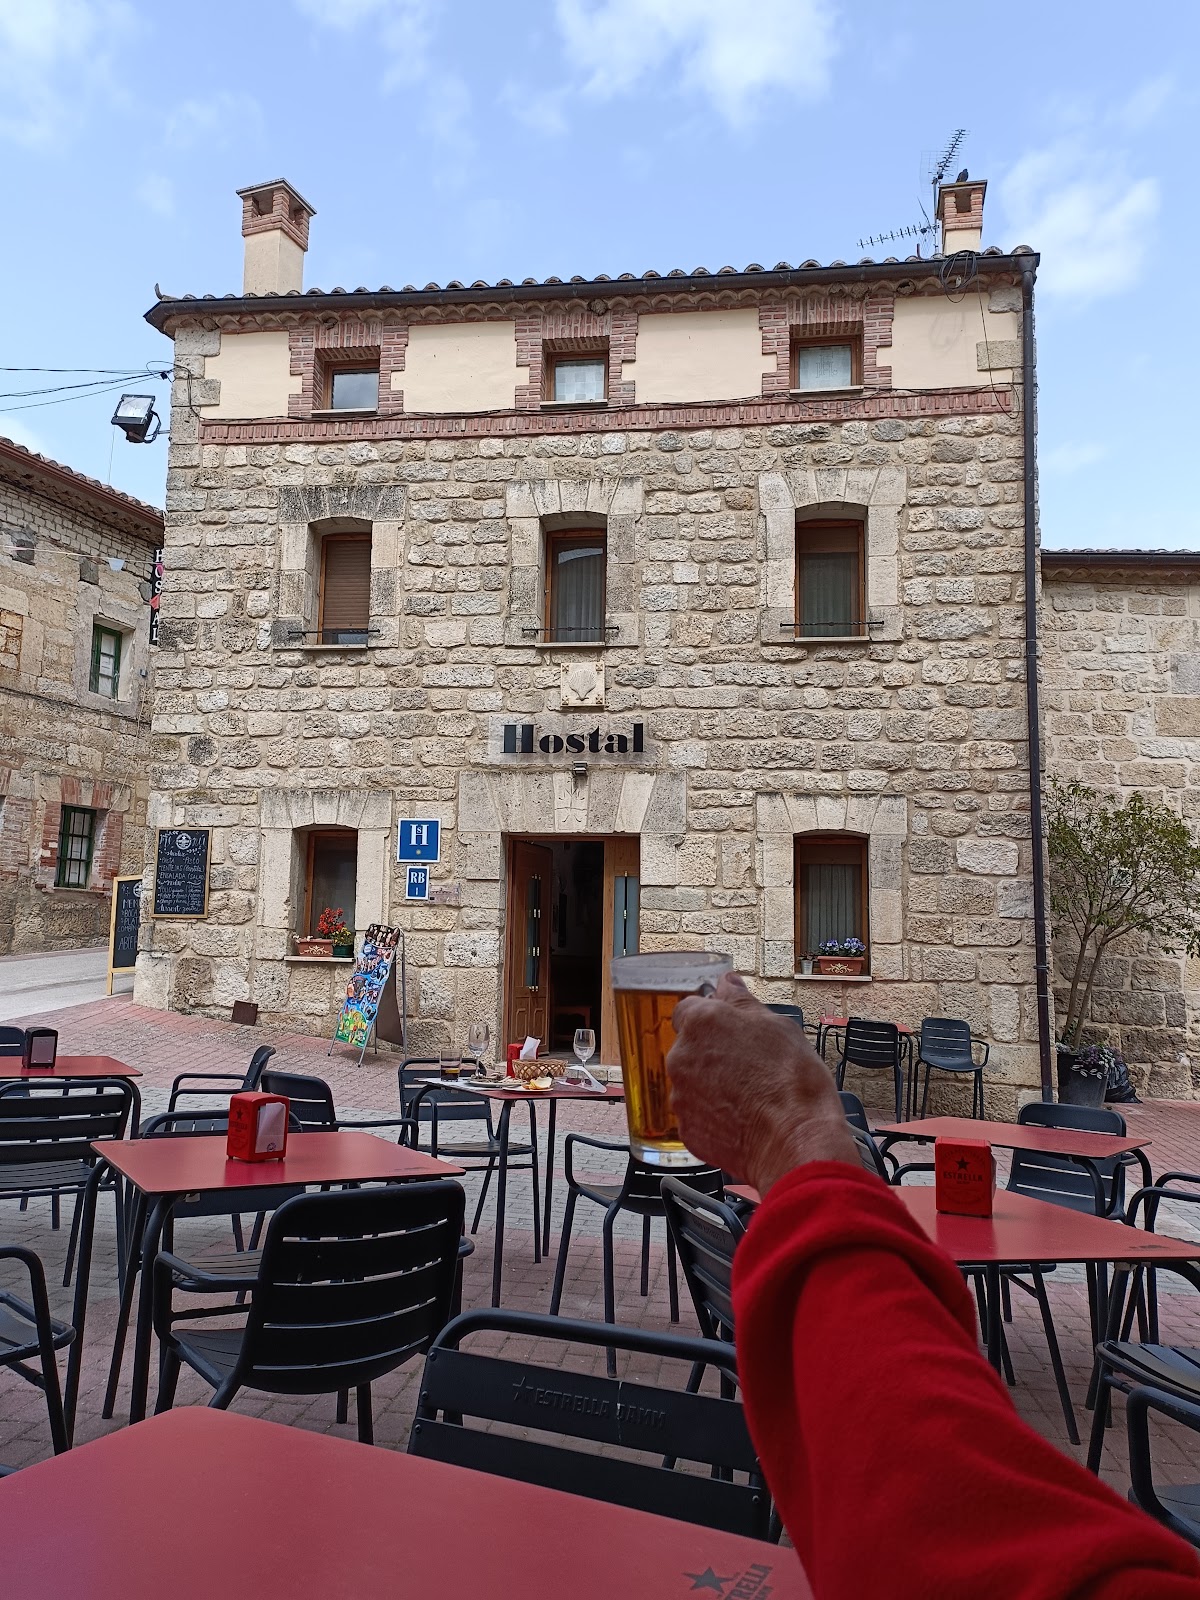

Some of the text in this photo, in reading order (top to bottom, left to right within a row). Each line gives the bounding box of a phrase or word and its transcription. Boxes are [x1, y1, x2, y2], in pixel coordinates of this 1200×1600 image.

[152, 549, 163, 641] HOSAL
[500, 722, 644, 754] Hostal
[410, 871, 425, 884] RB
[943, 1171, 984, 1182] ESTRELLA
[534, 1388, 610, 1418] ESTRELLA
